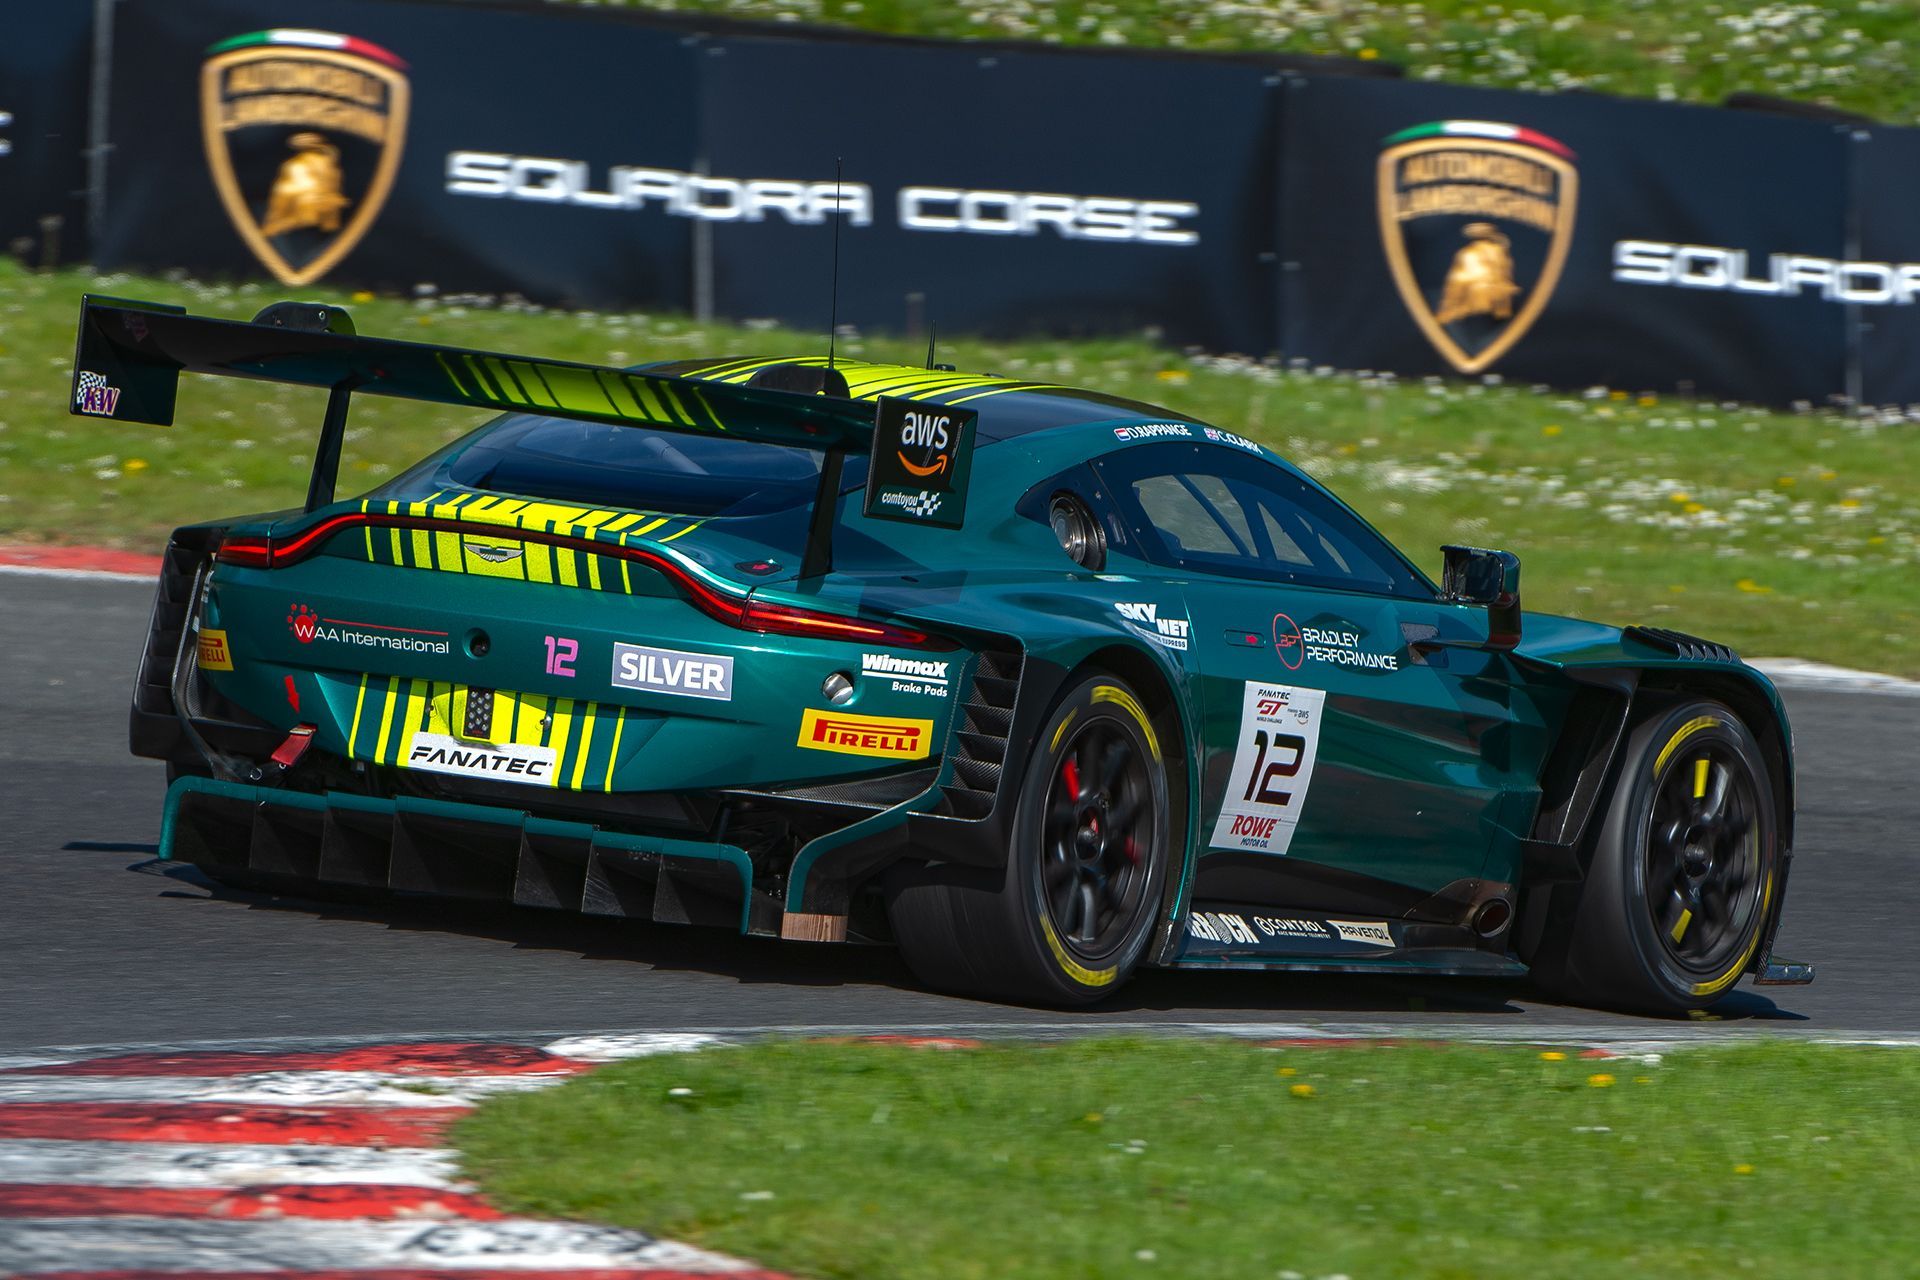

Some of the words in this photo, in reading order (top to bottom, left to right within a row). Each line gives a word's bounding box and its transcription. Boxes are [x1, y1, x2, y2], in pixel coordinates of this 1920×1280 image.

[445, 150, 873, 226] SQUADRA
[897, 185, 1199, 246] CORSE
[82, 386, 120, 416] KW
[901, 411, 950, 450] aws
[882, 492, 918, 508] comtoyou
[1114, 603, 1157, 623] SKY
[295, 622, 339, 642] WAA
[342, 629, 449, 654] International
[1156, 619, 1189, 637] NET
[1302, 627, 1359, 647] BRADLEY
[544, 635, 579, 678] 12
[1306, 646, 1398, 670] PERFORMANCE
[620, 652, 725, 692] SILVER
[892, 681, 922, 695] Brake
[924, 684, 948, 697] Pads
[1257, 689, 1291, 700] FANATEC
[812, 718, 921, 752] PIRELLI
[410, 745, 548, 777] FANATEC
[1243, 729, 1306, 807] 12
[1230, 814, 1278, 839] ROWE
[1240, 837, 1260, 847] MOTOR
[1340, 925, 1390, 940] RAVENOL
